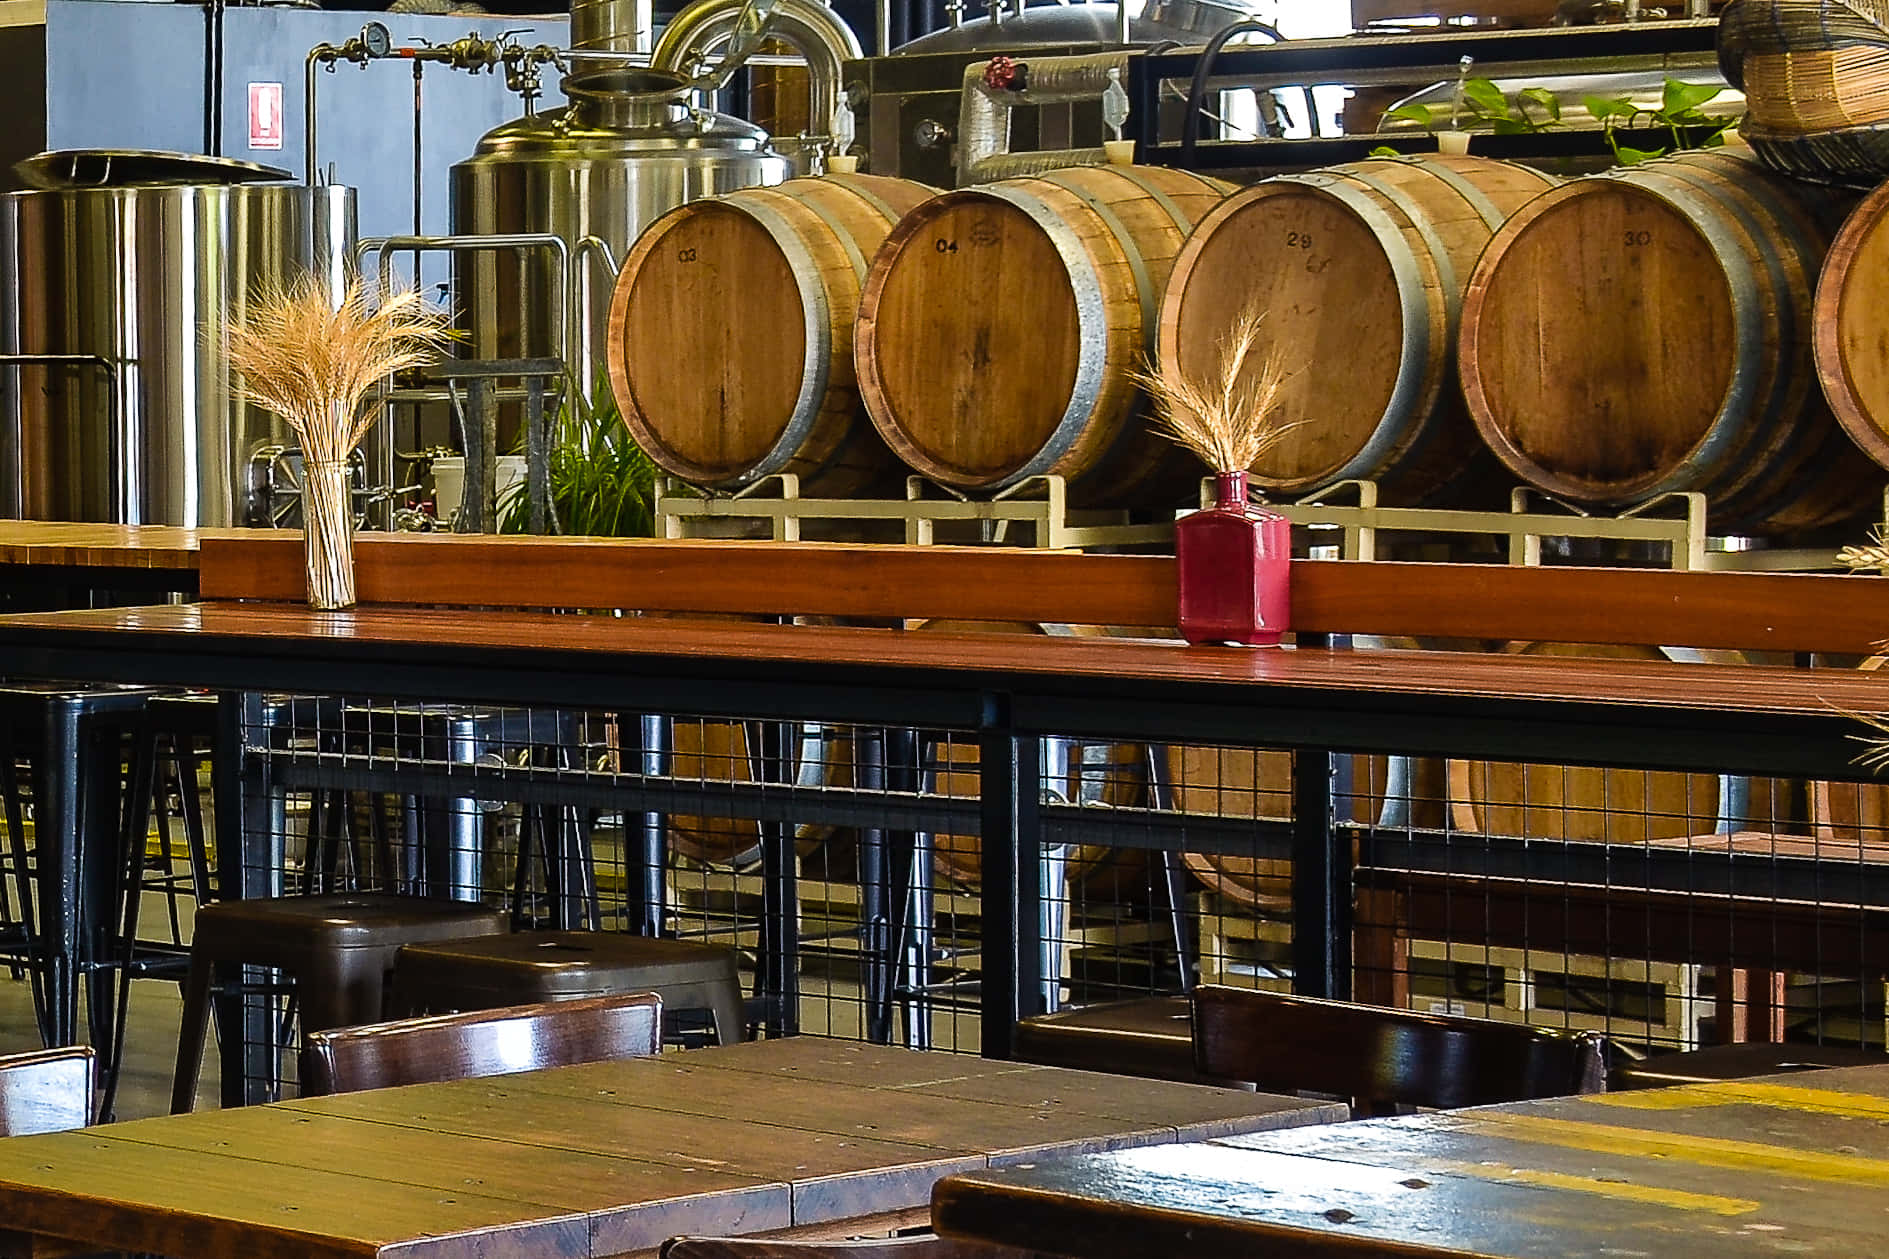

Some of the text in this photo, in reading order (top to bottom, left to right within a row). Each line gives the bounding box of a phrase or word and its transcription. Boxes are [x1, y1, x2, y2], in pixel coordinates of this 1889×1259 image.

[936, 238, 959, 254] 04
[1287, 232, 1312, 249] 29
[1624, 231, 1650, 247] 30
[679, 248, 697, 262] 03
